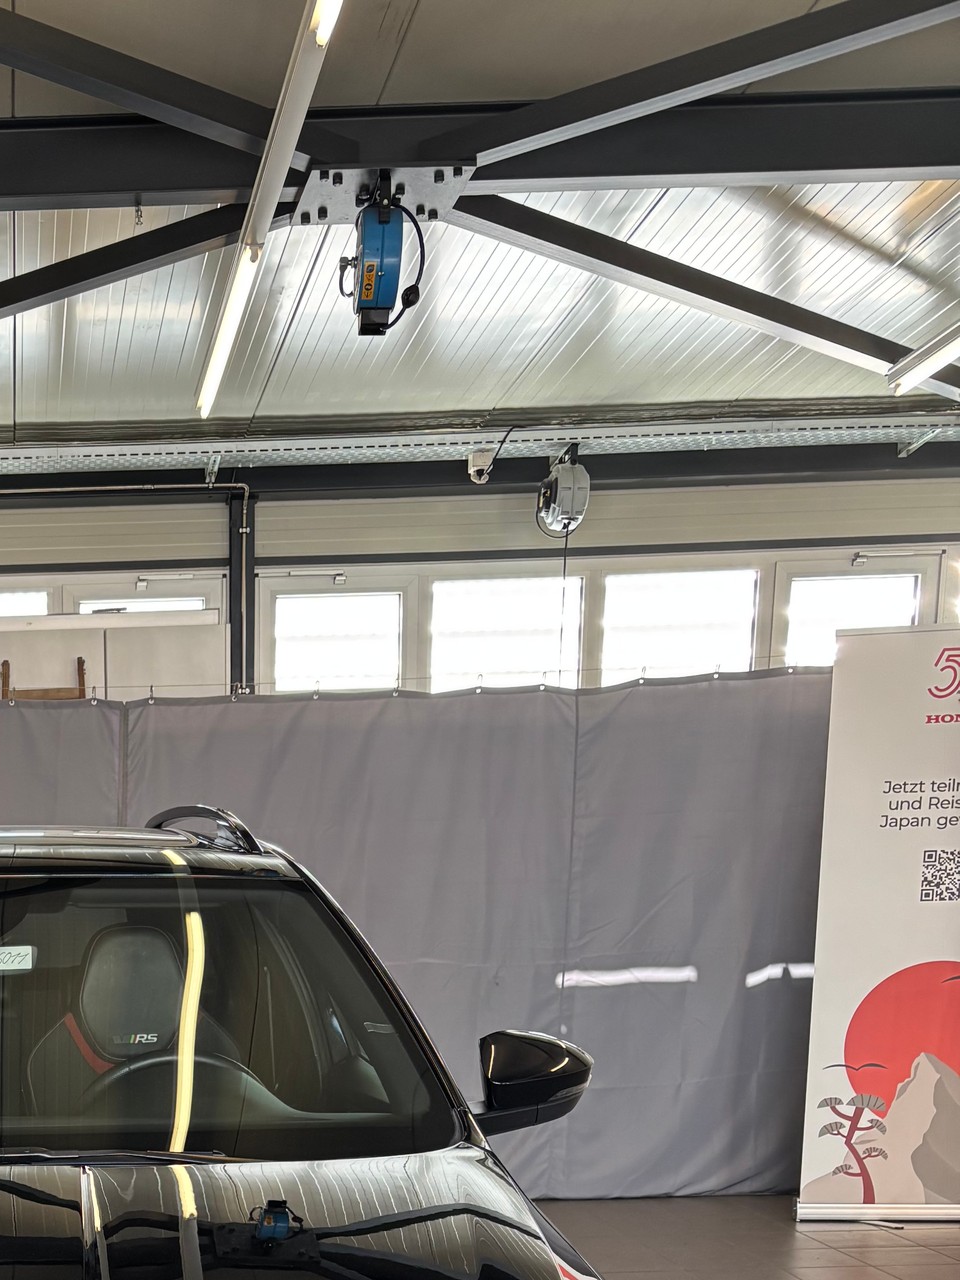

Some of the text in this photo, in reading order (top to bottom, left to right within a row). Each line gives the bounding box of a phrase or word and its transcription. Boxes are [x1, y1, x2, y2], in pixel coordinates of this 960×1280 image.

[882, 780, 926, 794] Jetzt
[888, 796, 923, 811] und
[879, 814, 960, 831] Japan ge
